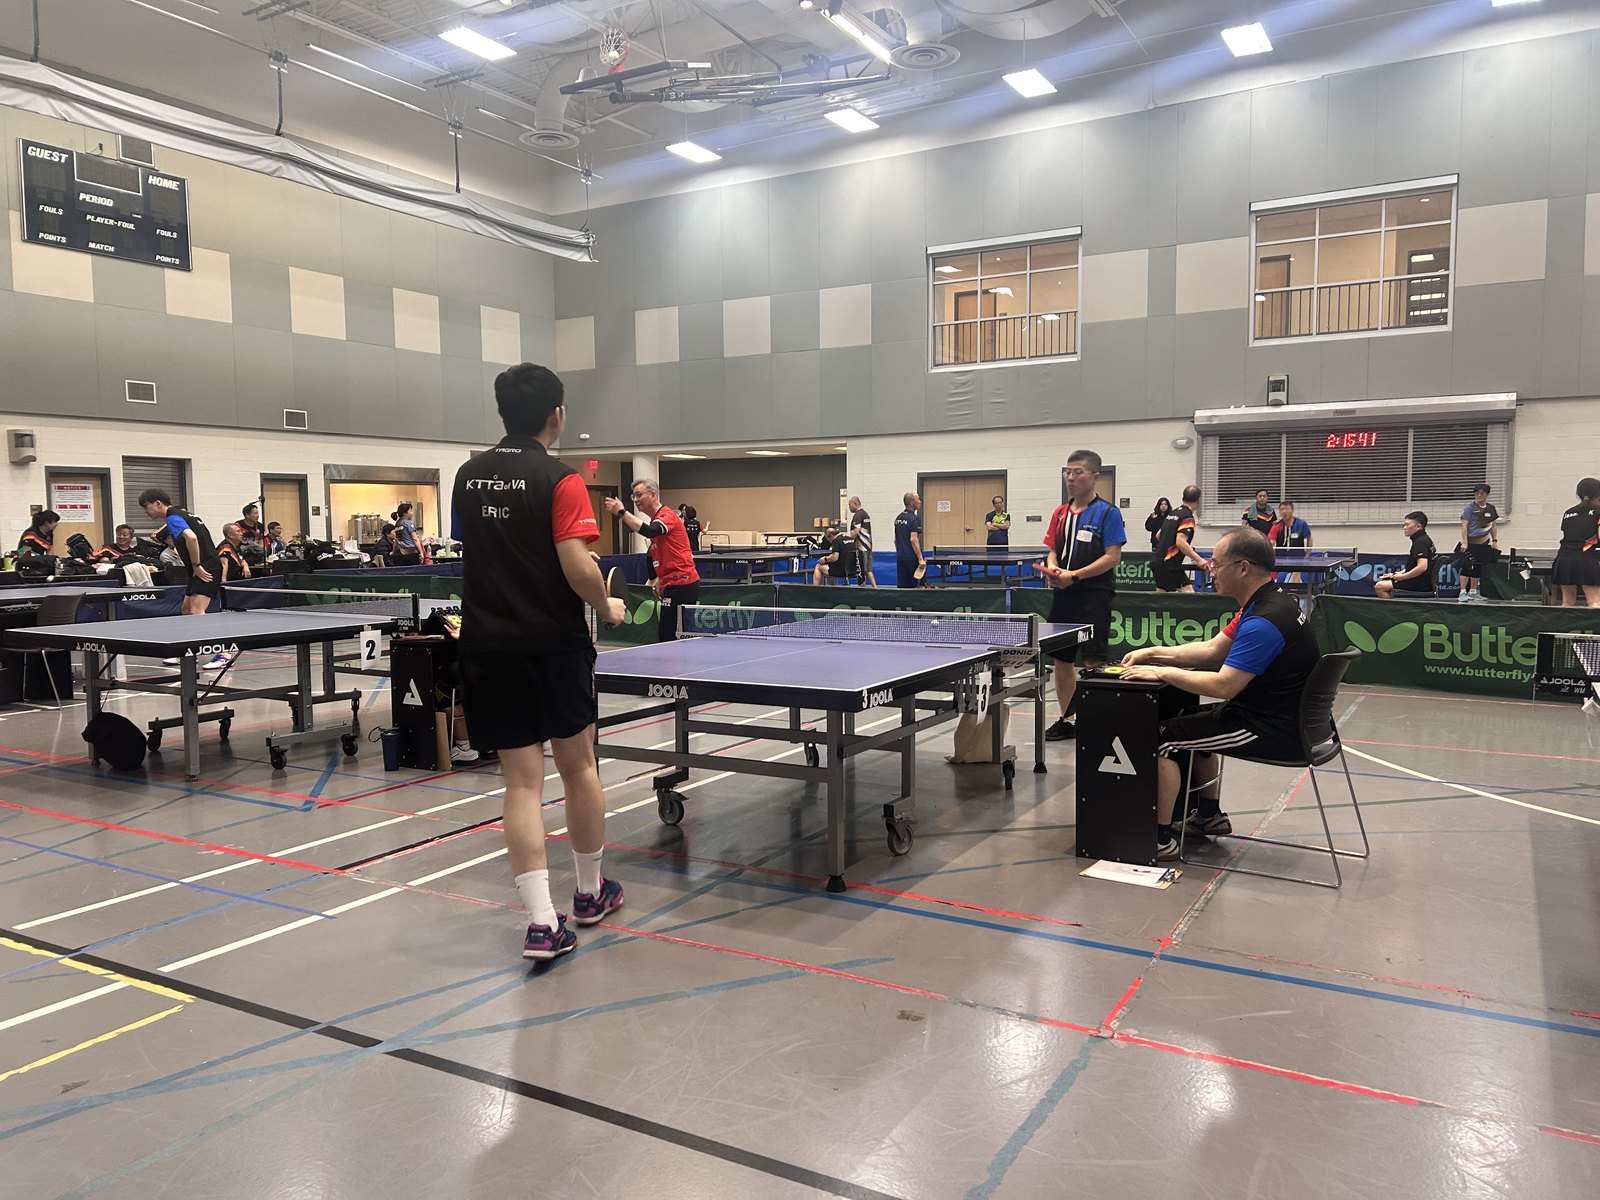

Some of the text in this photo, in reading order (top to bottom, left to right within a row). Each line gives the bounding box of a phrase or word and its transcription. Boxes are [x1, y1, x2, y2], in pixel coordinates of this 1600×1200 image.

[27, 145, 69, 164] GUEST
[148, 175, 180, 191] HOME
[79, 192, 114, 207] PERIOD
[39, 204, 64, 215] FOULS
[86, 214, 136, 230] PLAYER-FOUL
[38, 232, 67, 243] POINTS
[156, 228, 178, 239] FOULS
[88, 241, 115, 252] MATCH
[155, 254, 180, 265] POINTS
[481, 505, 510, 519] ERIC
[128, 593, 157, 601] JOOLA
[81, 643, 107, 653] JOOLA
[196, 642, 240, 656] JOOLA
[365, 640, 376, 660] 2
[1423, 623, 1537, 666] Butte
[1549, 677, 1586, 686] JOOLA
[648, 684, 689, 699] JOOLA
[862, 688, 894, 709] 3 JOOLA
[980, 683, 988, 713] 3
